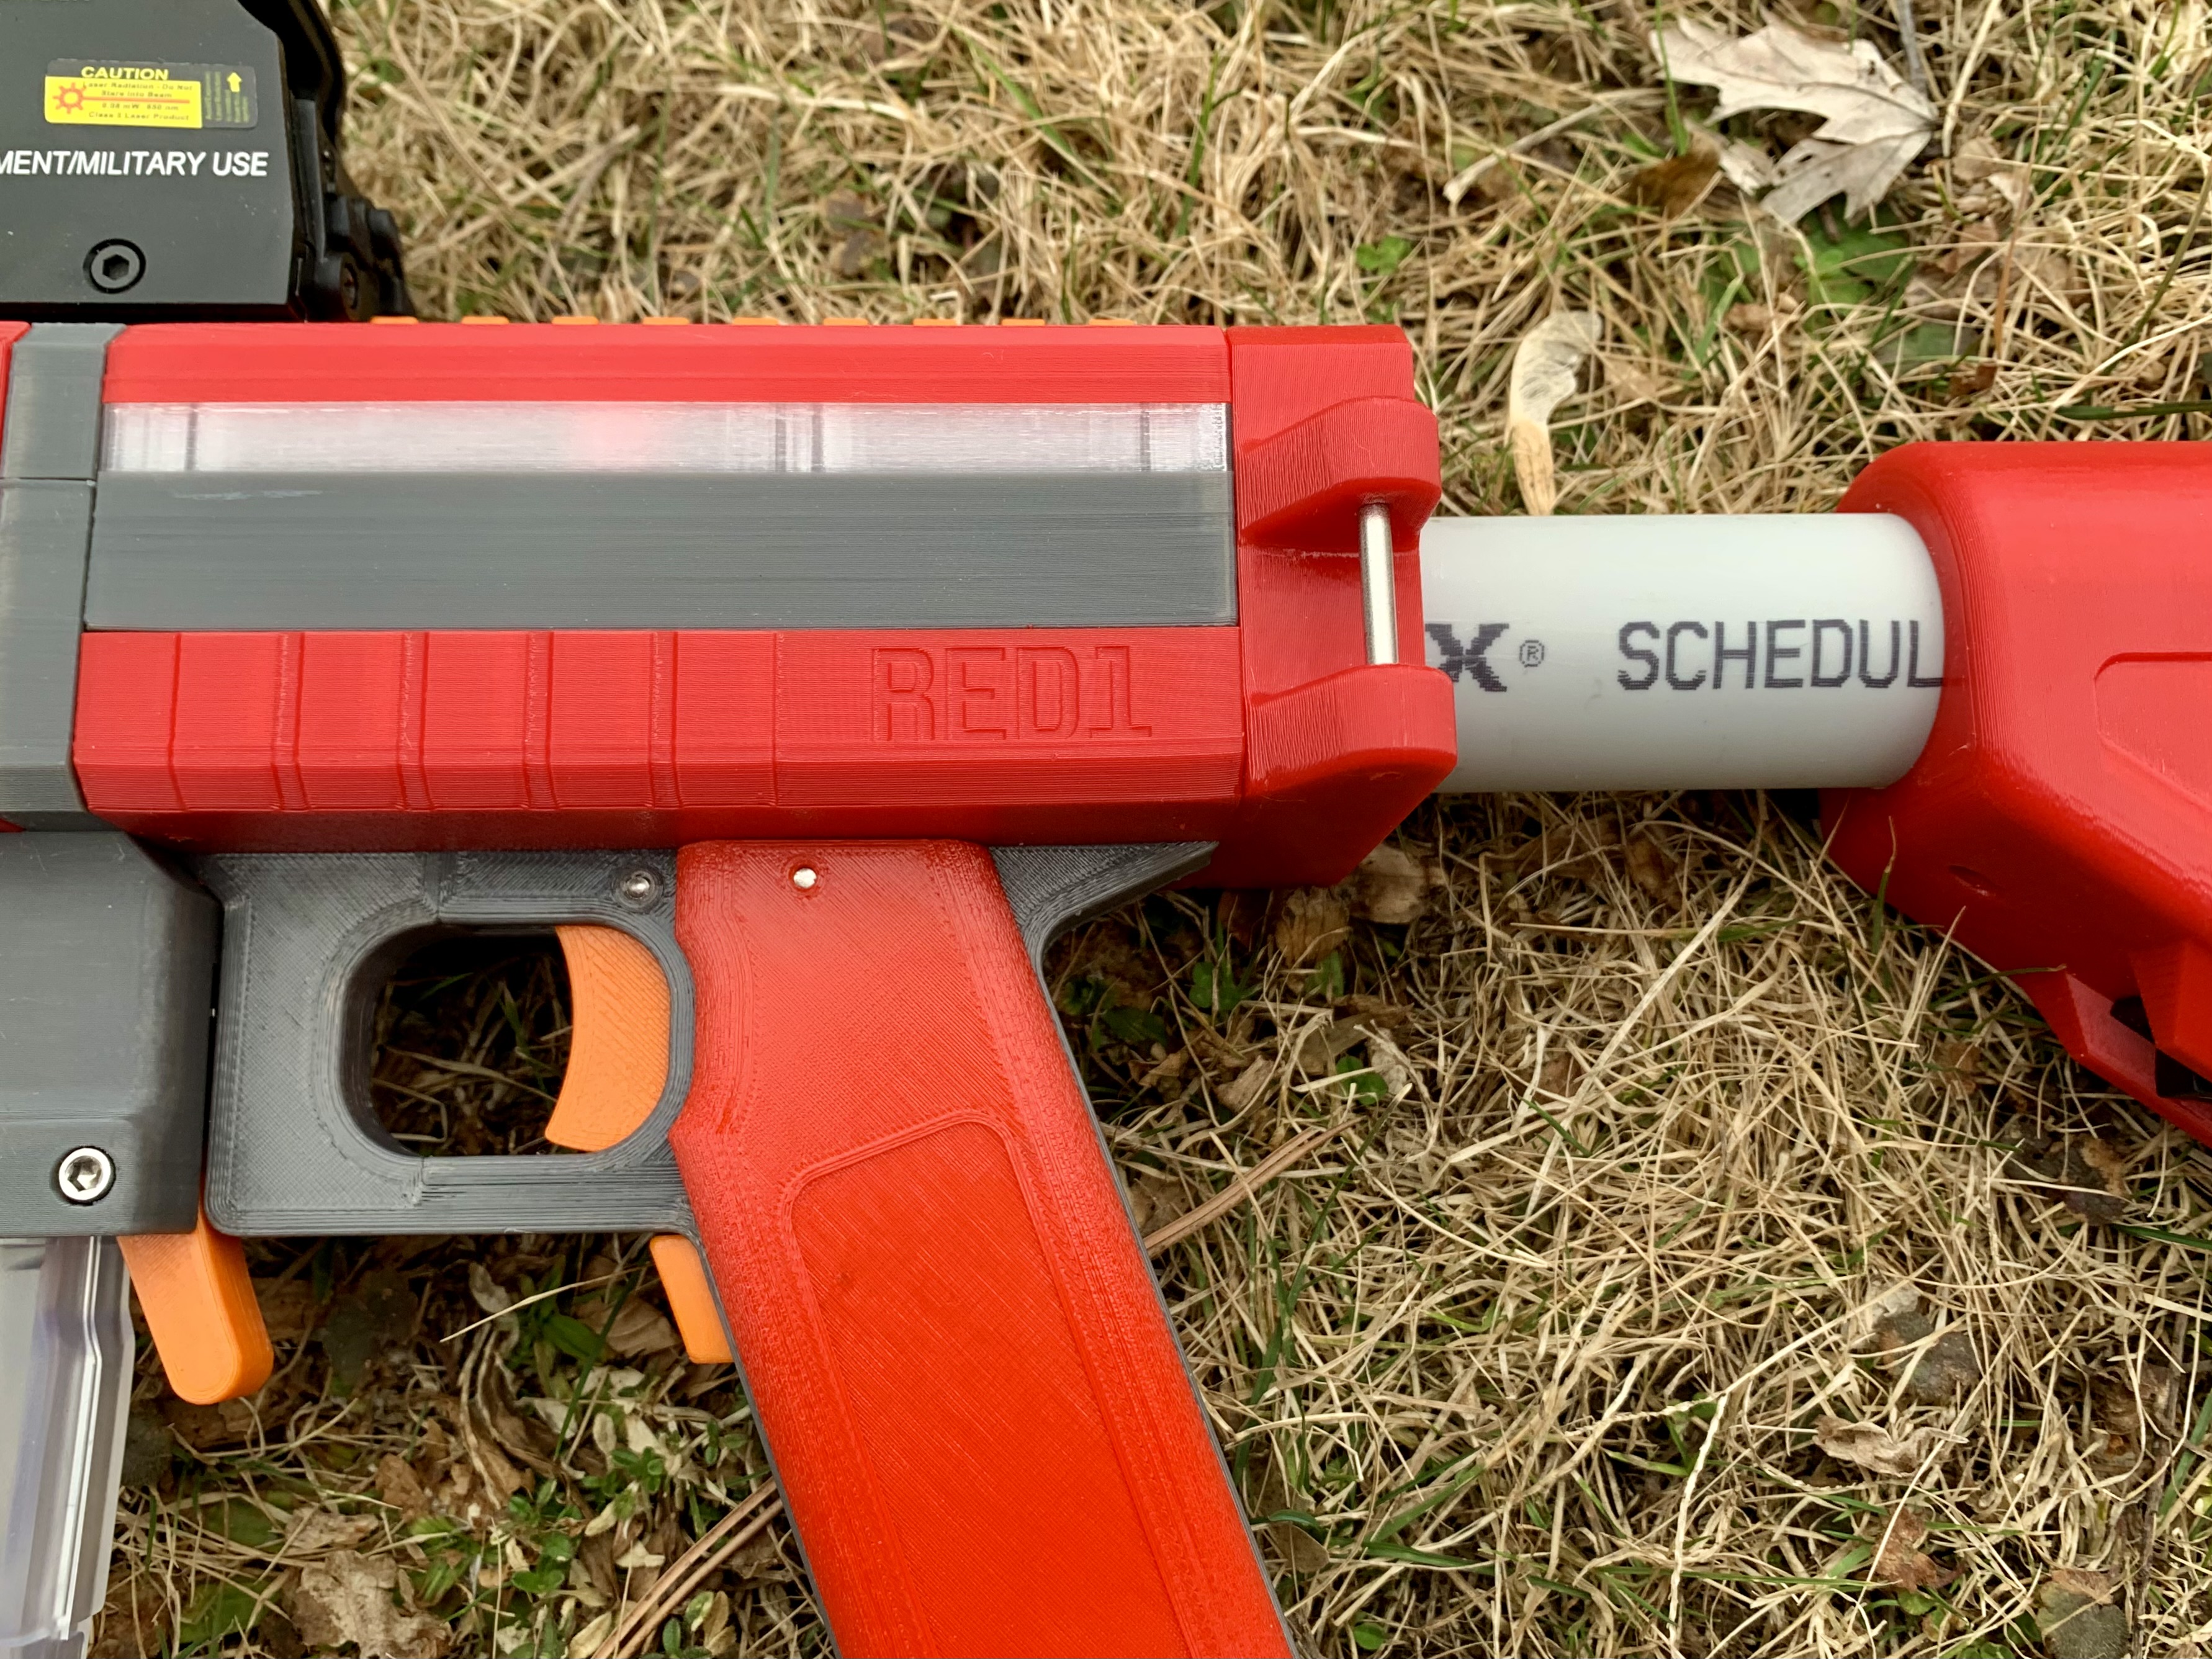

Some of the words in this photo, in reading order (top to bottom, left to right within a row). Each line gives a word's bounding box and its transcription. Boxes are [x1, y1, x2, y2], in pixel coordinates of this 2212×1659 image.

[81, 66, 169, 80] CAUTION
[212, 151, 269, 177] USE
[871, 645, 1153, 742] RED1
